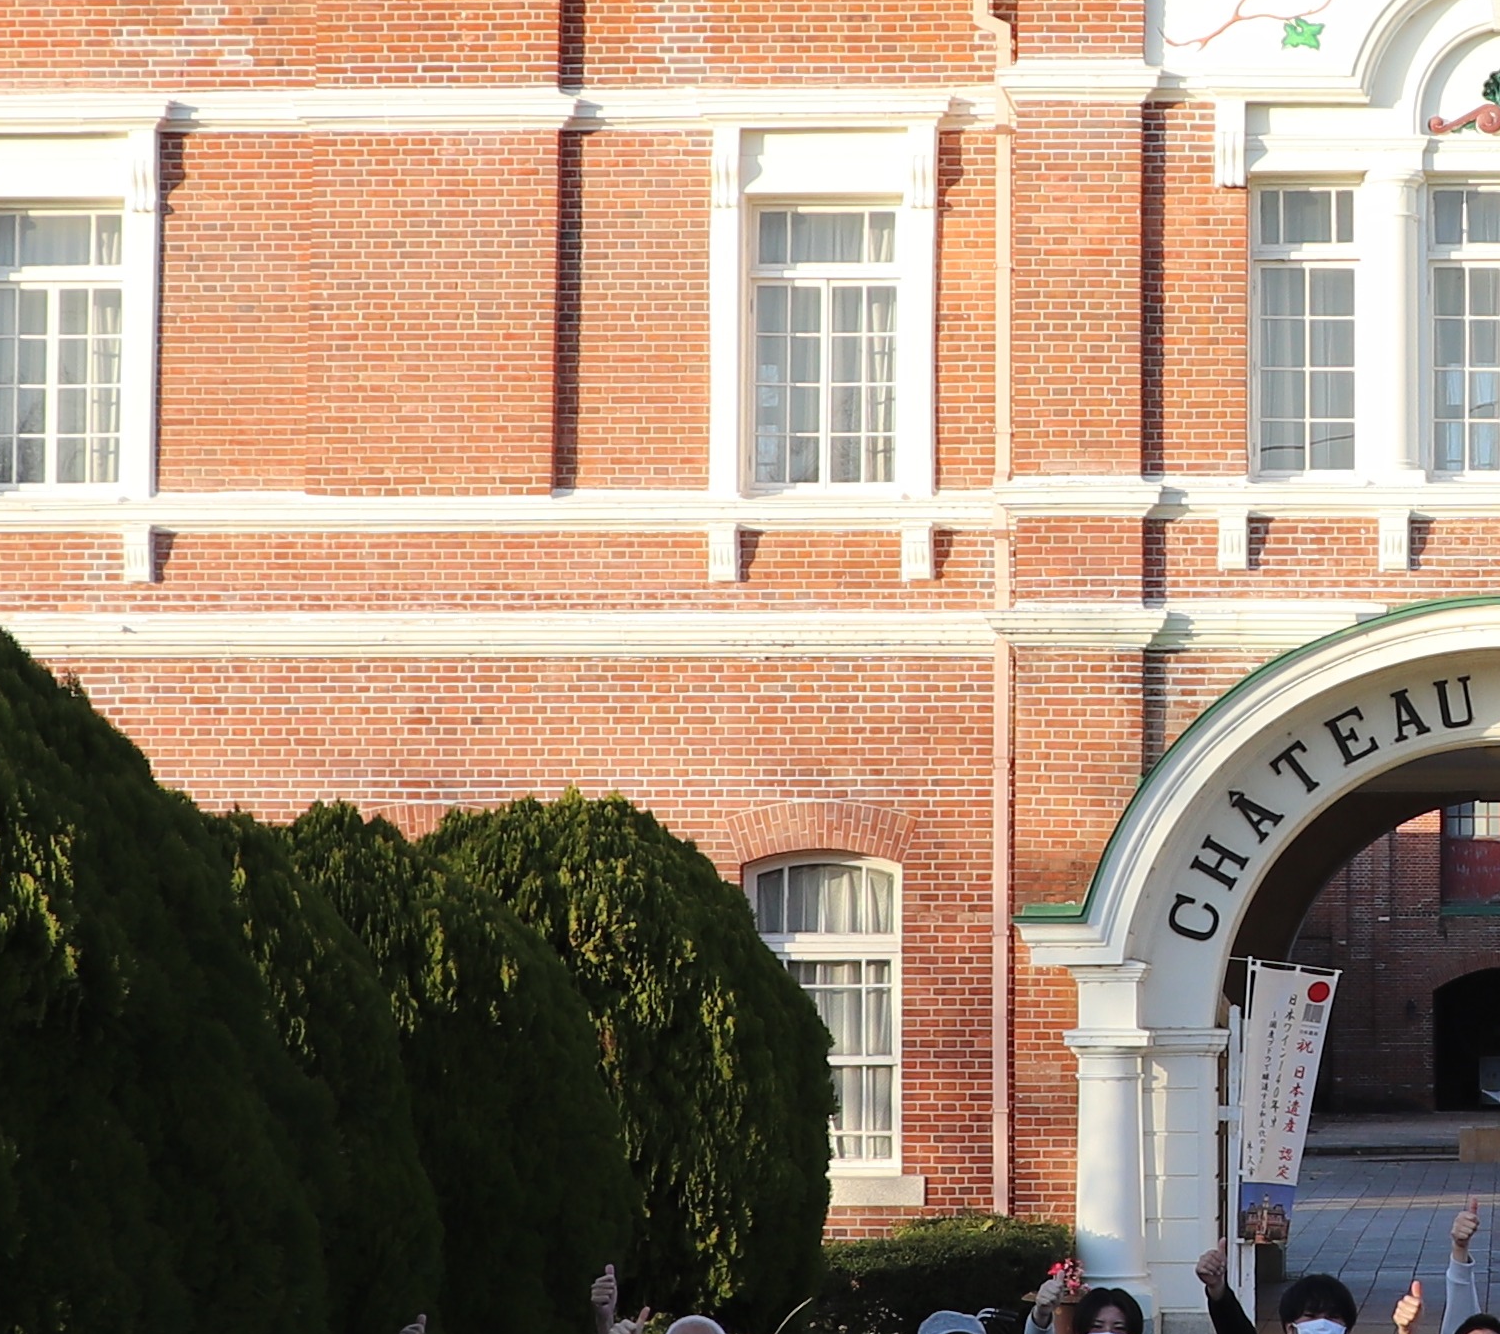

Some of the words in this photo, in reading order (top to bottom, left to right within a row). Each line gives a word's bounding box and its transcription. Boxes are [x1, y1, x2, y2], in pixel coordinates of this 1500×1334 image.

[1169, 676, 1475, 942] CHÂTEAU
[1296, 1038, 1314, 1055] 祝
[1282, 1066, 1305, 1134] 日本遺産
[1276, 1147, 1293, 1180] 認定
